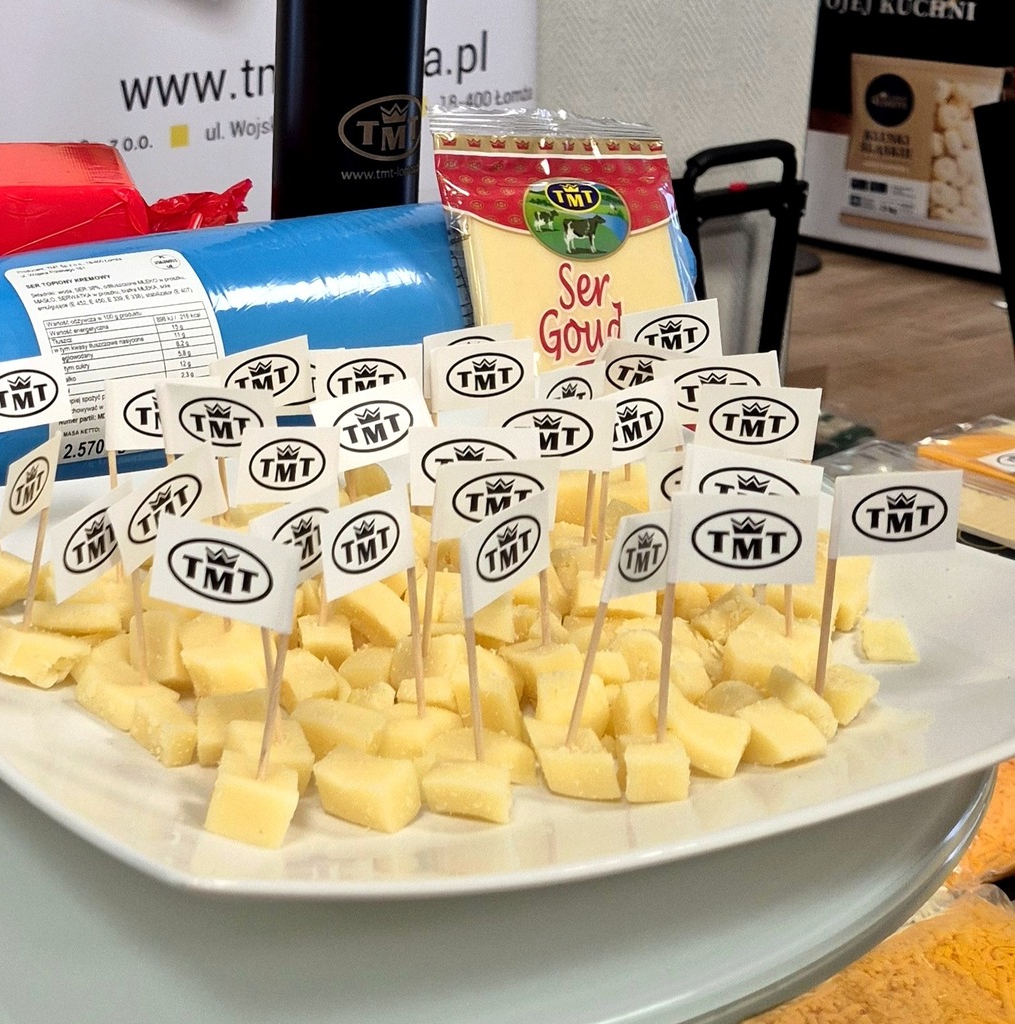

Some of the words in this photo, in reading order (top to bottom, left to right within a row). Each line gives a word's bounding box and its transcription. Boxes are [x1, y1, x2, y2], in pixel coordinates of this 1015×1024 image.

[205, 122, 224, 141] ul.
[229, 116, 273, 139] Wojs
[552, 190, 592, 207] TMT
[41, 279, 73, 287] TOPIONY
[74, 274, 110, 283] KREMOWY
[558, 263, 609, 310] Ser
[46, 319, 69, 327] Wartość
[73, 325, 109, 334] energetyczna
[539, 301, 622, 361] Goud
[71, 344, 87, 352] kwasy
[89, 340, 118, 349] tłuszczowe
[119, 337, 144, 345] nasycone
[644, 327, 698, 350] TMT
[64, 365, 74, 373] tym
[235, 366, 288, 390] TMT
[457, 367, 513, 391] TMT
[190, 413, 250, 440] TMT
[343, 413, 400, 445] TMT
[722, 413, 786, 437] TMT
[63, 439, 105, 459] 2.570
[260, 458, 315, 482] TMT
[15, 469, 45, 507] TMT
[865, 505, 935, 534] TMT
[341, 527, 390, 566] TMT
[486, 528, 533, 573] TMT
[708, 531, 787, 560] TMT
[625, 543, 663, 574] TMT
[183, 554, 259, 594] TMT
